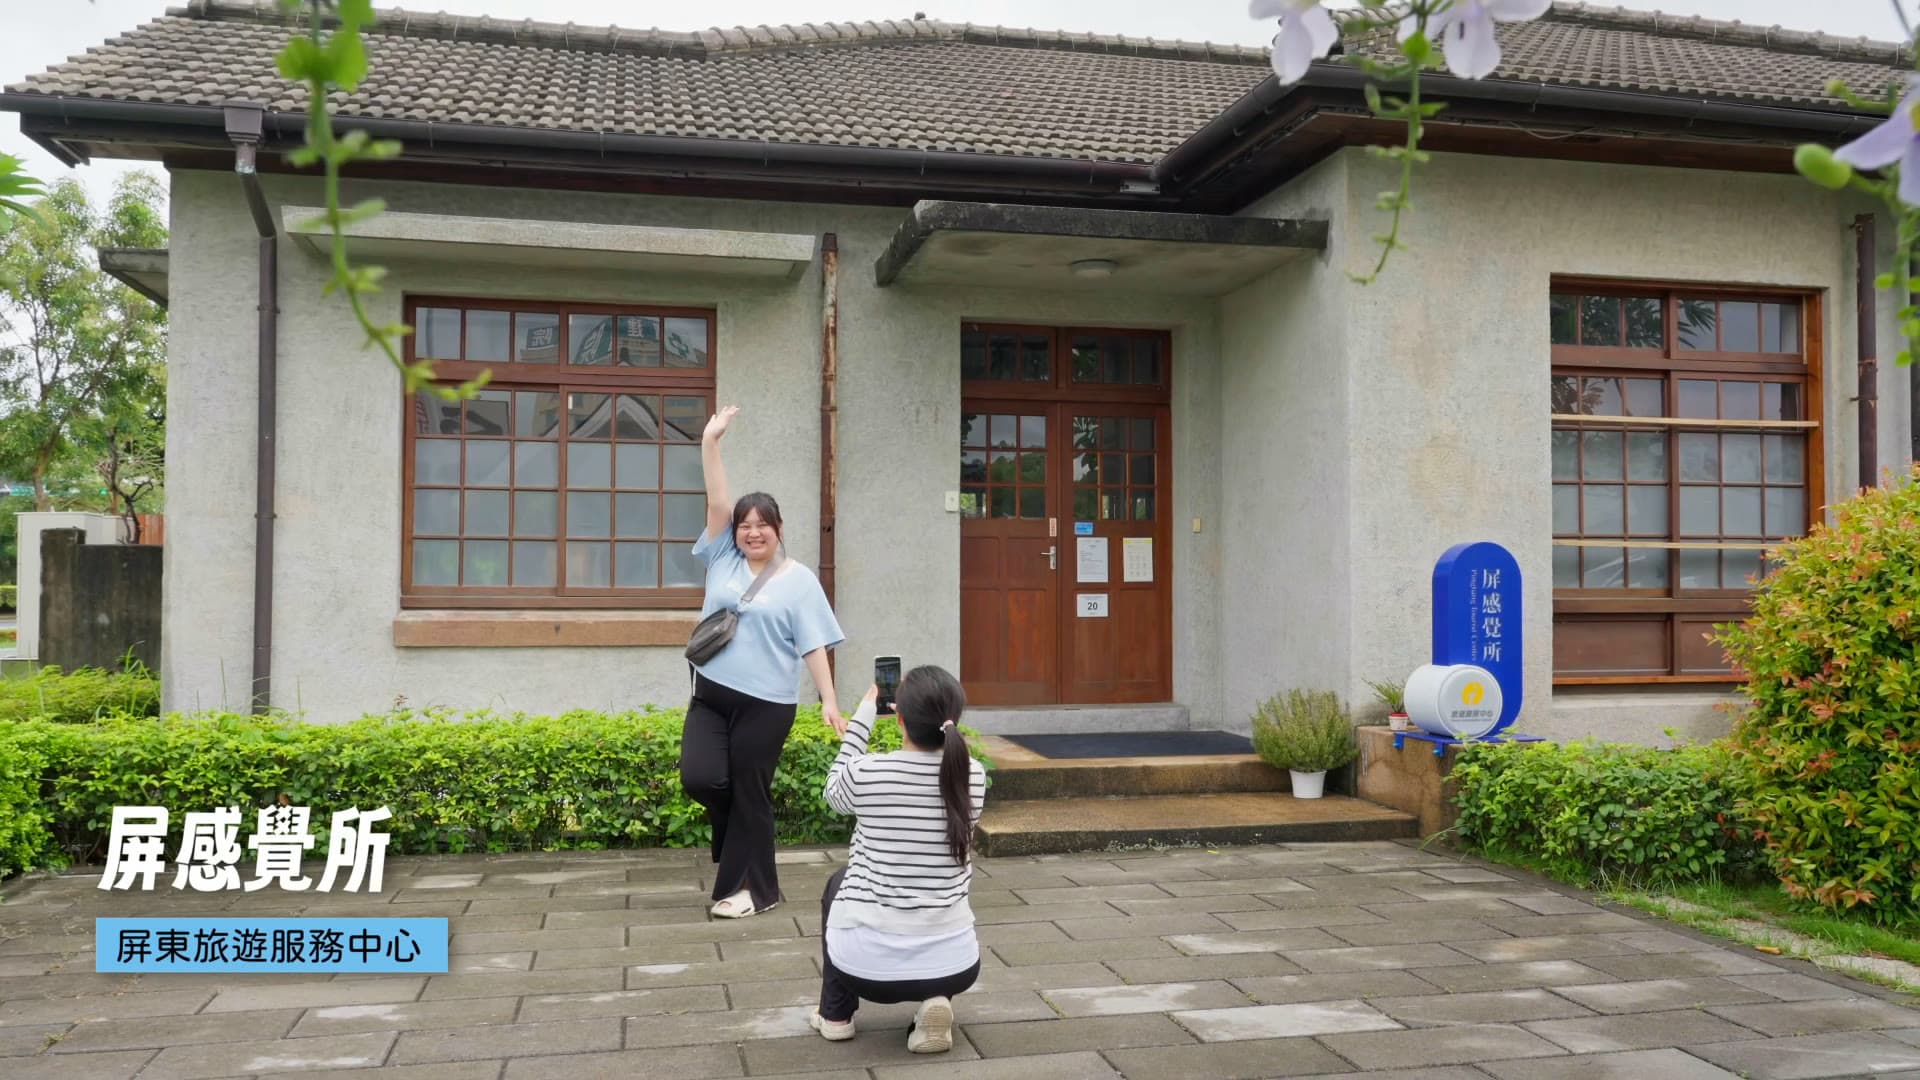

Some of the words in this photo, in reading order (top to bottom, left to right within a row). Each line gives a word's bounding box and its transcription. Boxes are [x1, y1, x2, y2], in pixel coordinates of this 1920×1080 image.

[1087, 602, 1098, 611] 20
[1482, 568, 1501, 663] 屏感覺所
